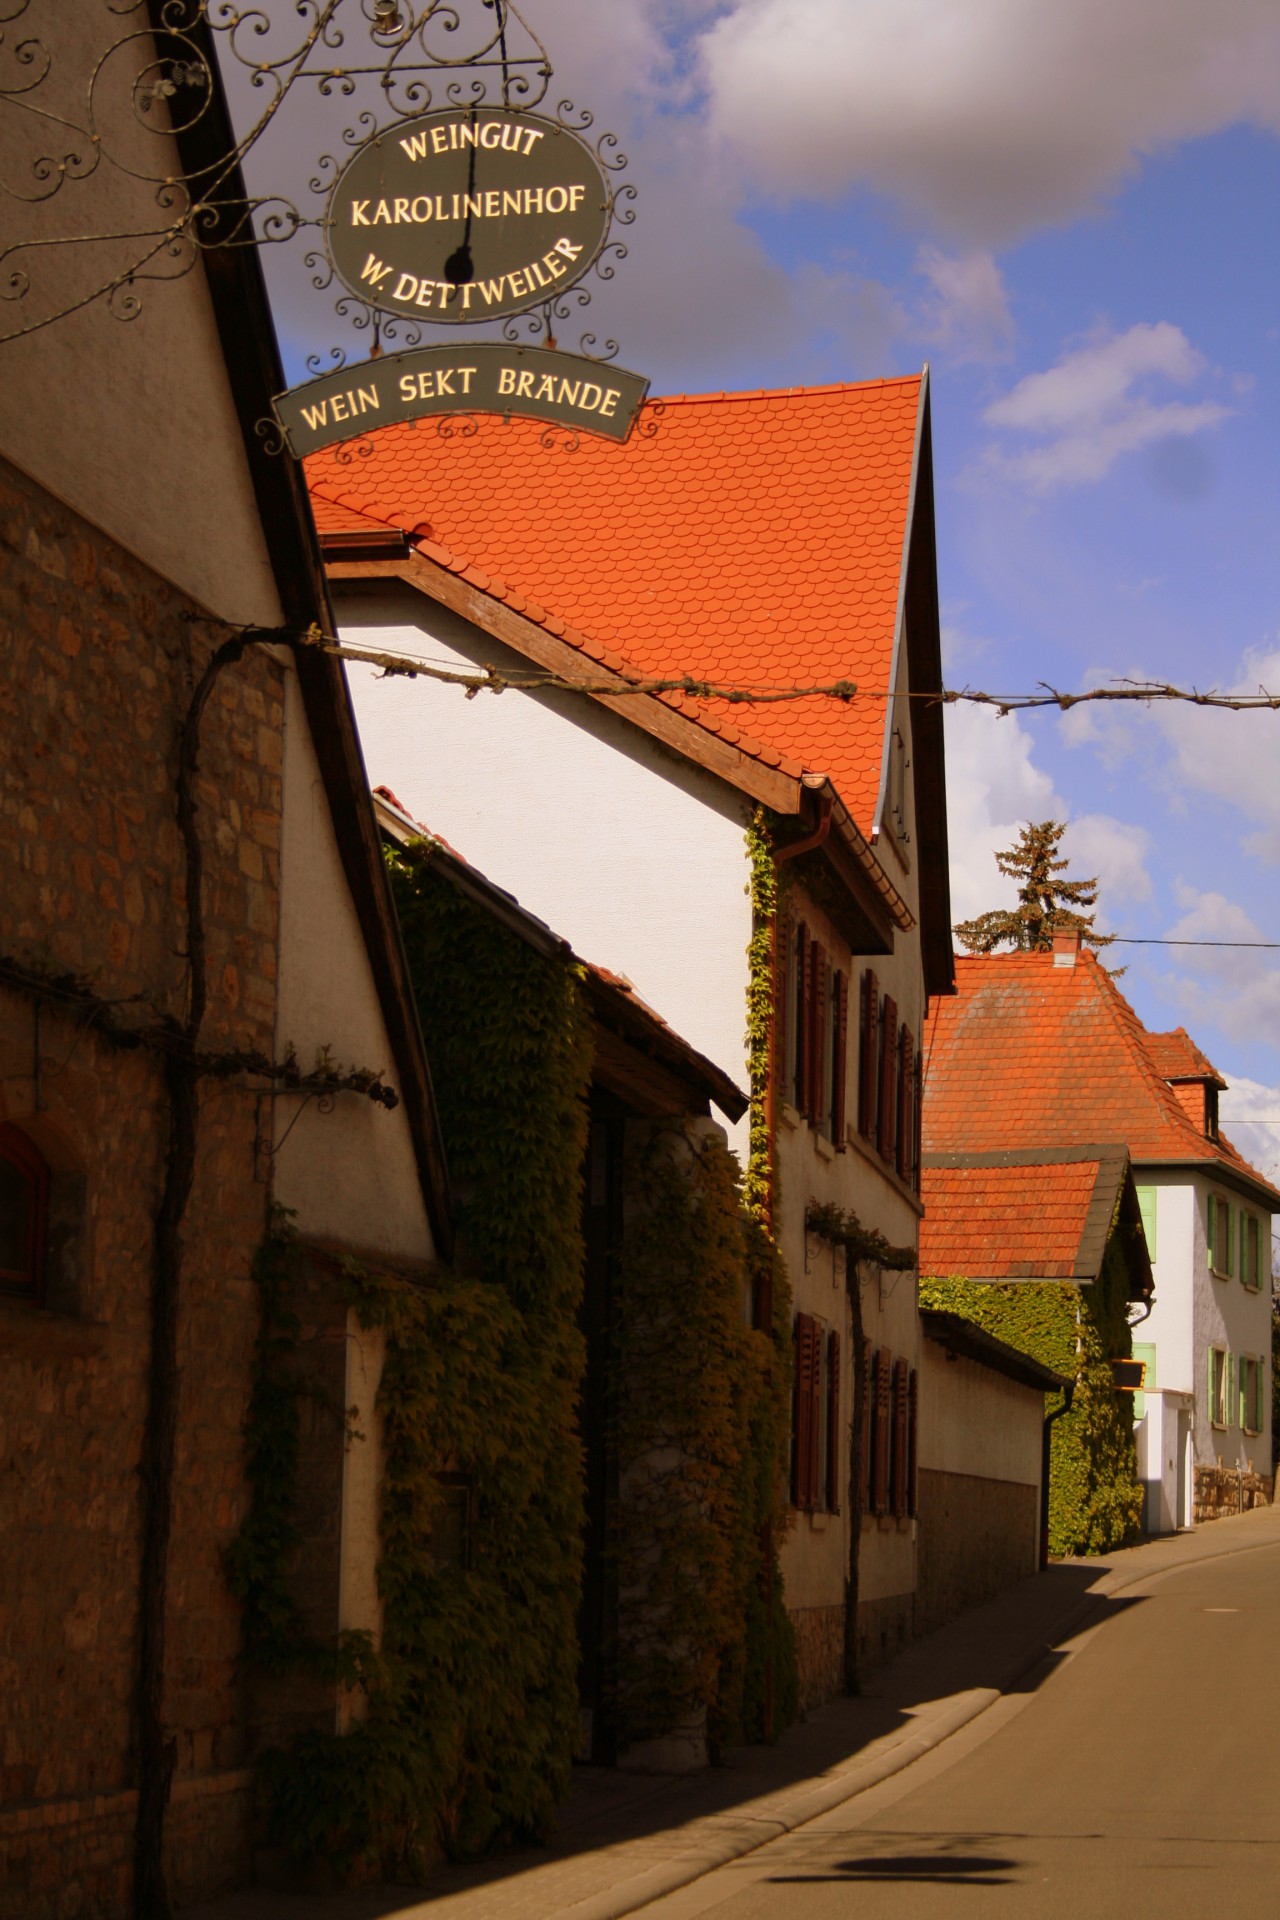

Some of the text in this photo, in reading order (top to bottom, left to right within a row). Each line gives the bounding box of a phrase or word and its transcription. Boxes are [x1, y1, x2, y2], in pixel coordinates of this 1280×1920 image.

[399, 122, 544, 162] WEINGUT
[351, 185, 586, 226] KAROLINENHOF
[360, 235, 584, 309] W. DETTWEILER
[301, 367, 622, 431] WEIN SEKT BRÄNDE
